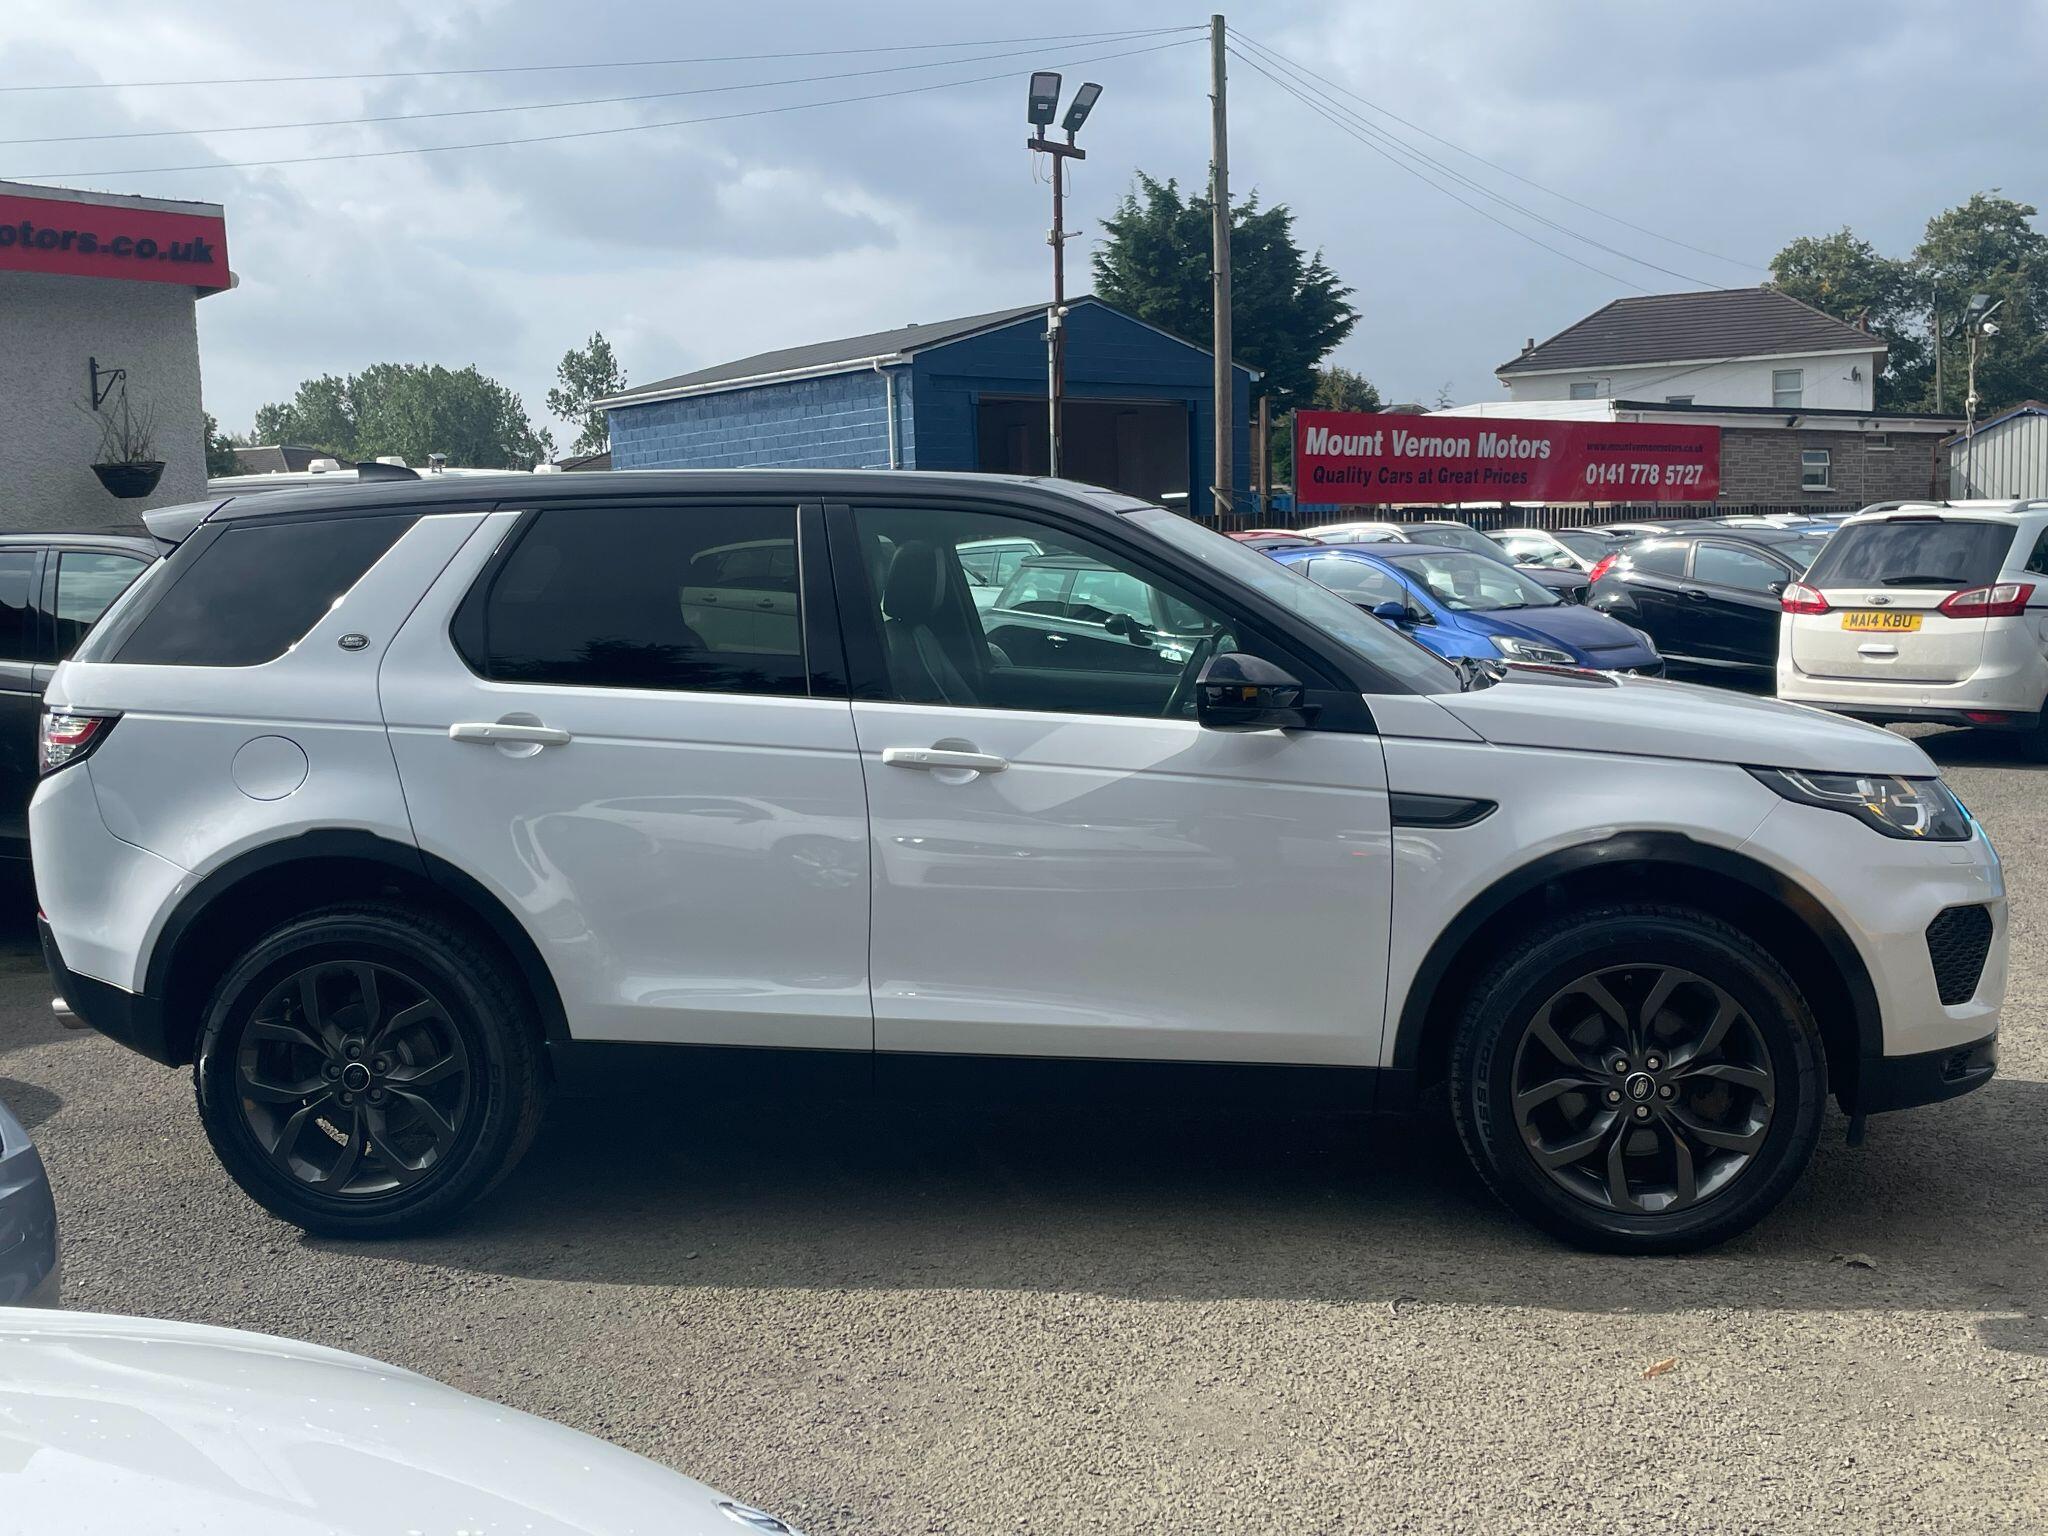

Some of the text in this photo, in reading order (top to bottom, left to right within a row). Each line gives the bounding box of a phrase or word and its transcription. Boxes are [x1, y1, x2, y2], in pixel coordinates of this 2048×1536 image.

[1305, 427, 1551, 459] Mount Vernon Motors
[1313, 465, 1528, 487] Quality Cars at Great Prices
[1586, 463, 1703, 485] 0141 778 5727
[1849, 614, 1913, 628] MA14 KBU
